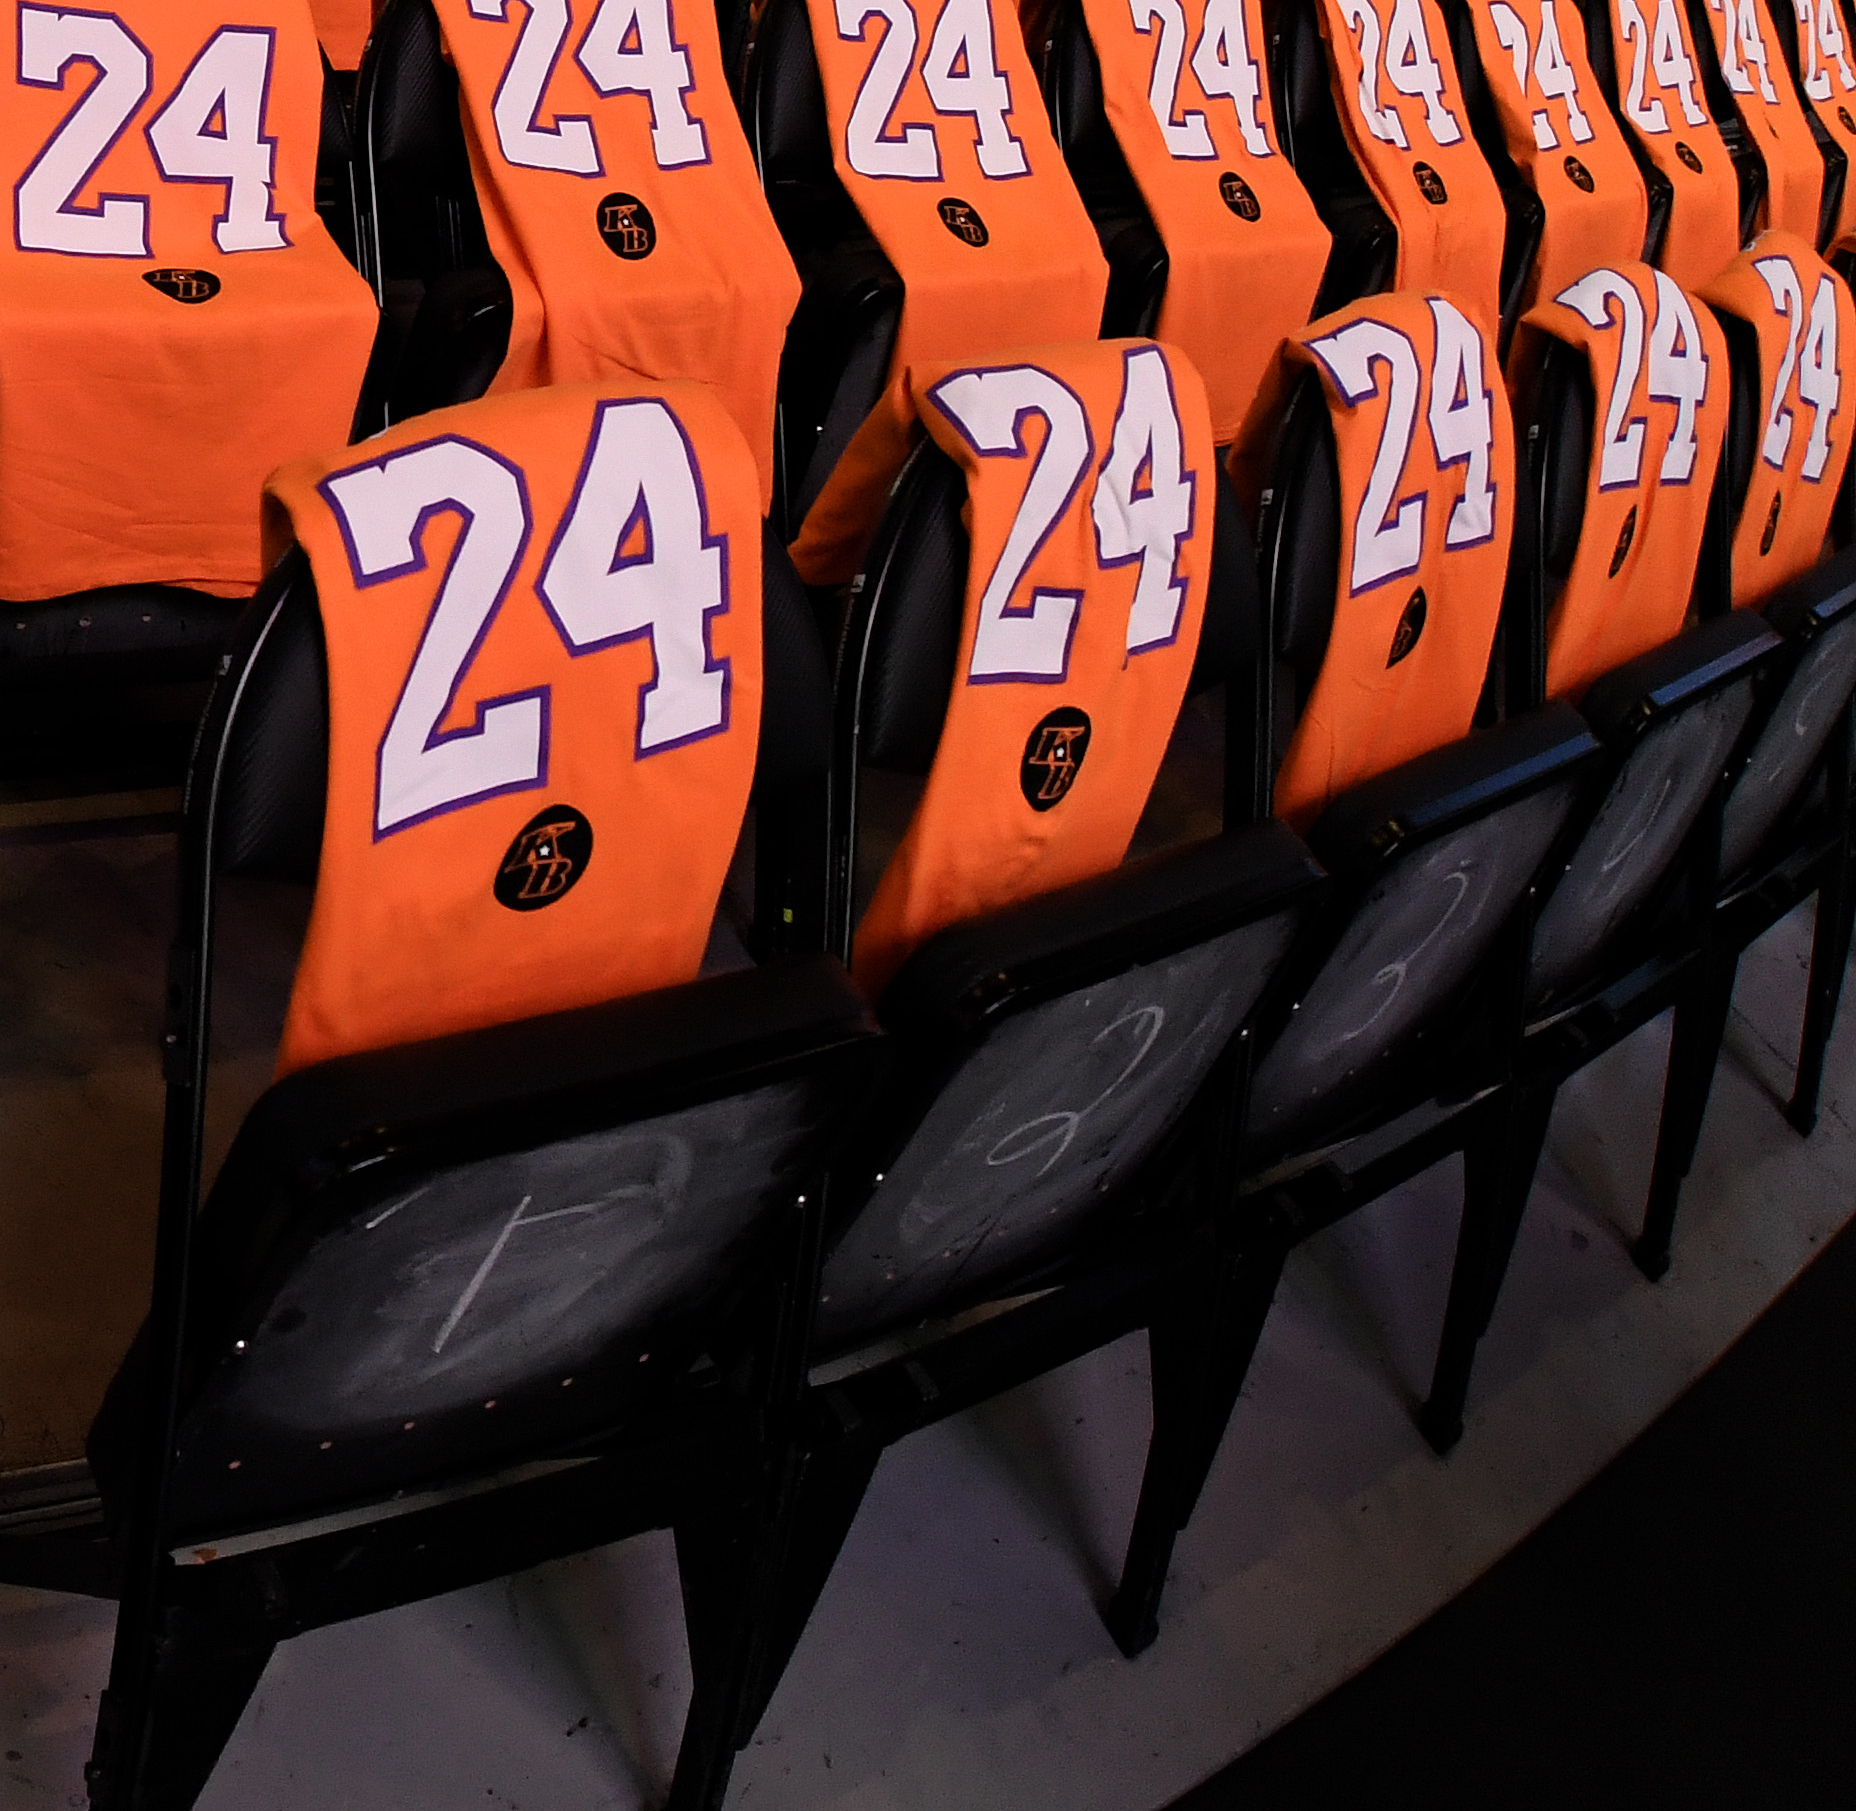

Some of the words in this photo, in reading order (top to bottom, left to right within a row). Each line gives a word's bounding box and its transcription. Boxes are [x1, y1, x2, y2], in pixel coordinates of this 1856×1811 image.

[14, 1, 293, 258] 24
[1304, 297, 1498, 597] 24
[1554, 267, 1709, 492] 24
[1750, 255, 1843, 482] 24
[317, 396, 730, 844] 24
[927, 342, 1197, 685] 24
